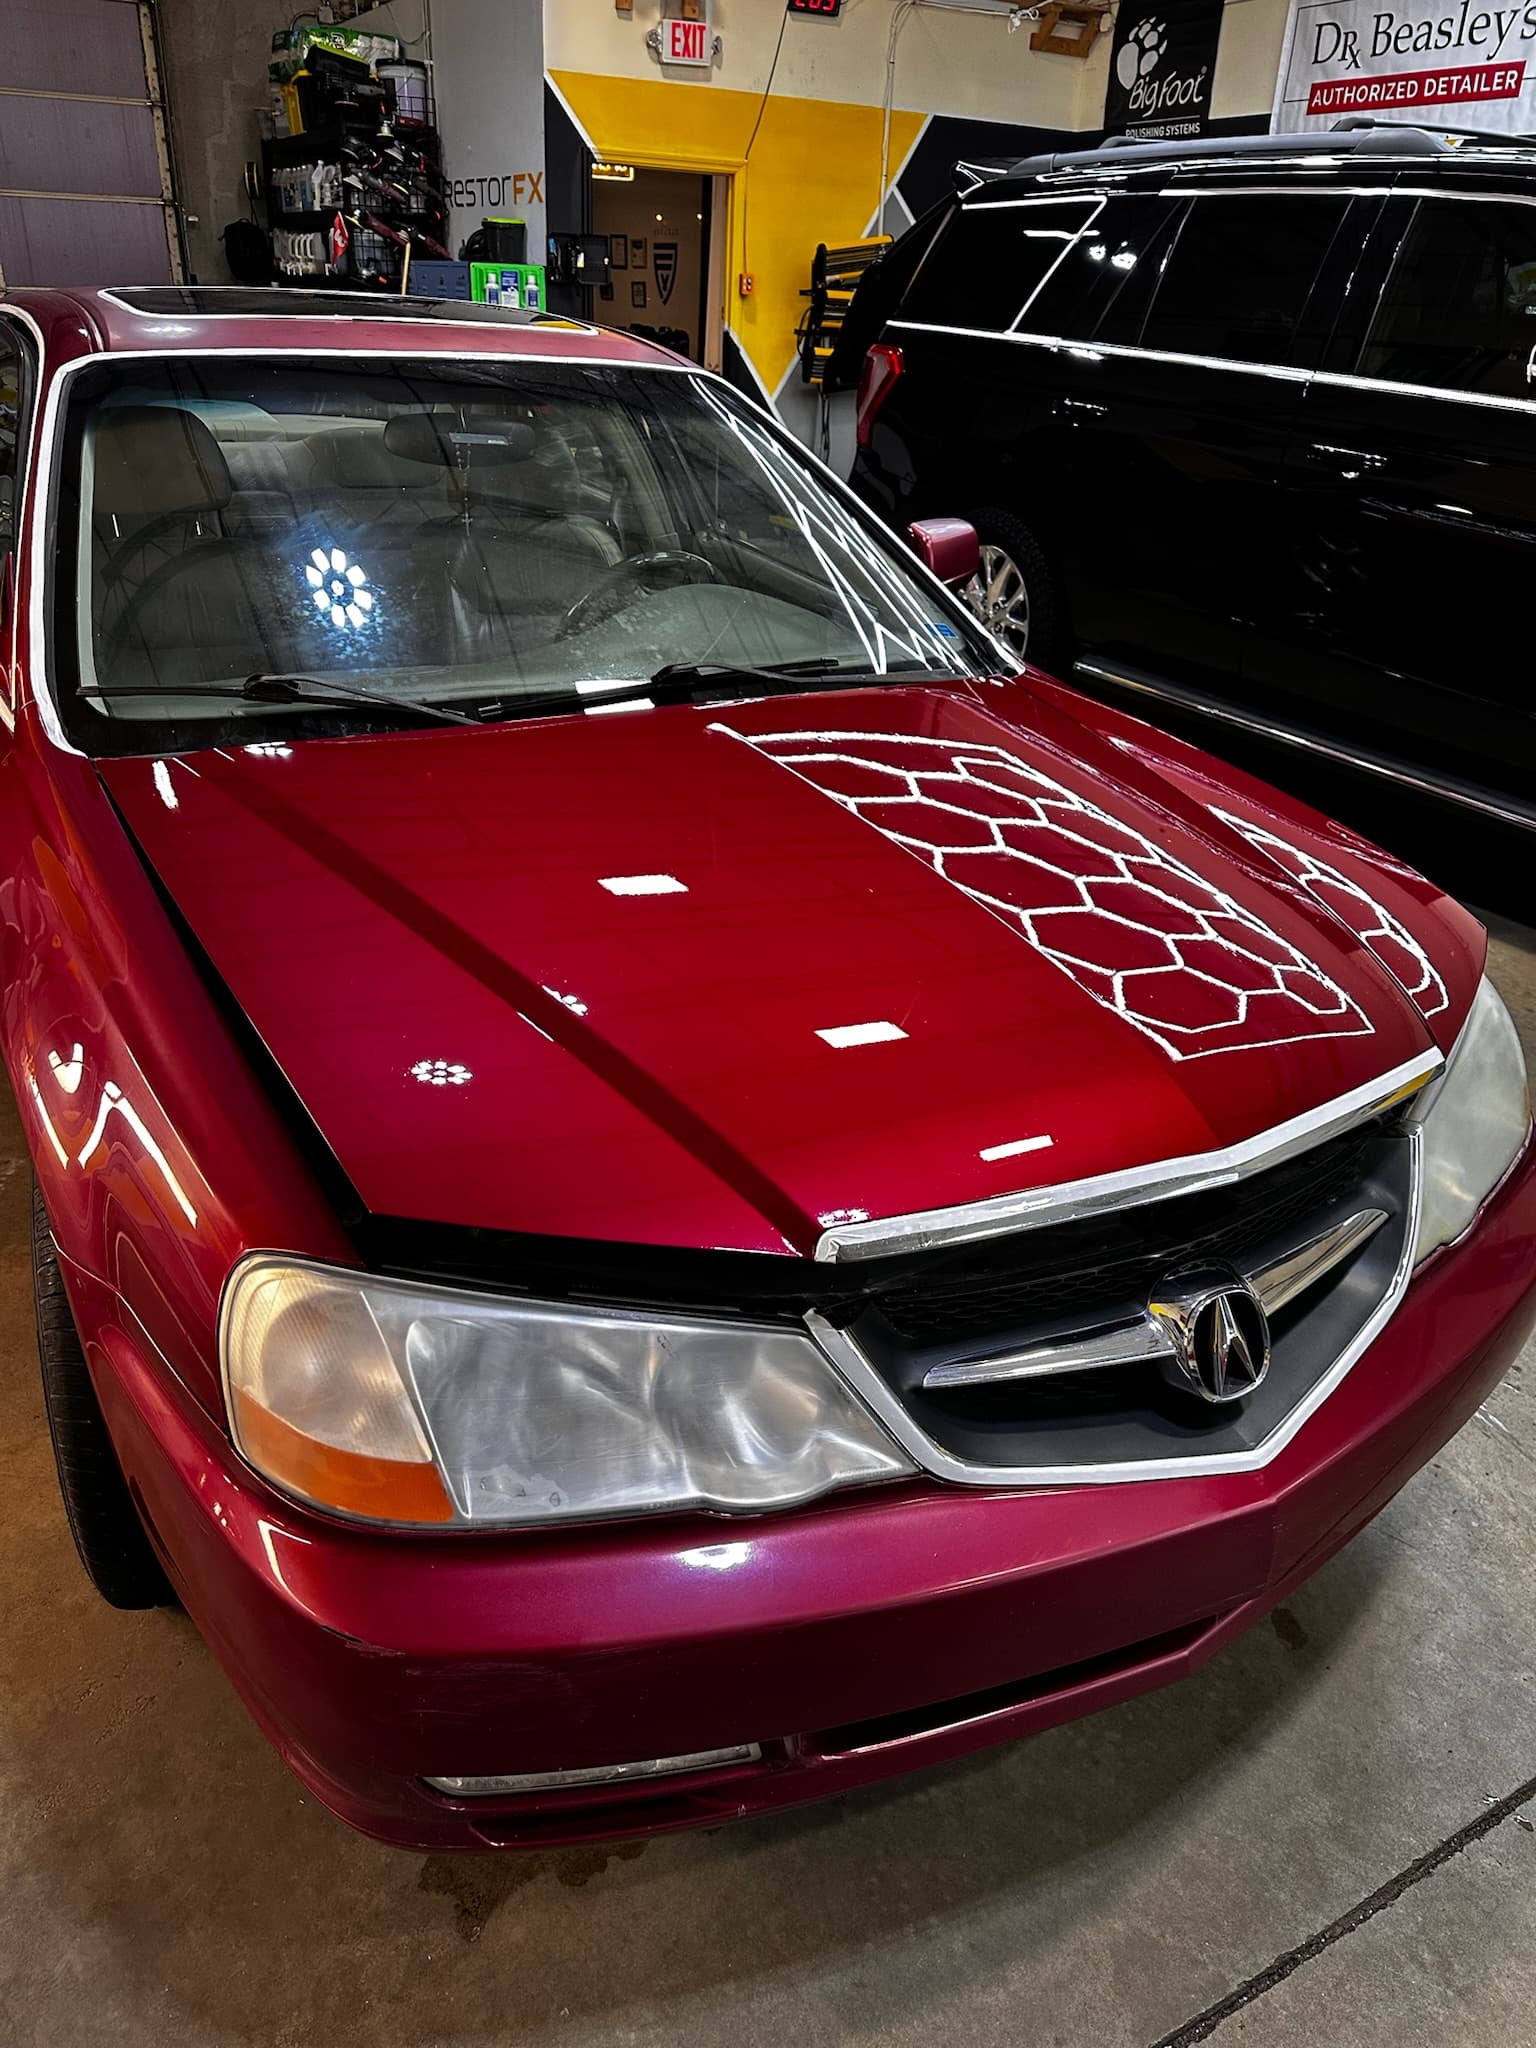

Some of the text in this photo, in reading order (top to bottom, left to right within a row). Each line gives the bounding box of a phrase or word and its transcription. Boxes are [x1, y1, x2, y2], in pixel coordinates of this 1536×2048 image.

[671, 22, 706, 59] EXIT
[1311, 69, 1519, 107] AUTHORIZED DETAILER
[1125, 122, 1200, 138] POLISHING SYSTEMS
